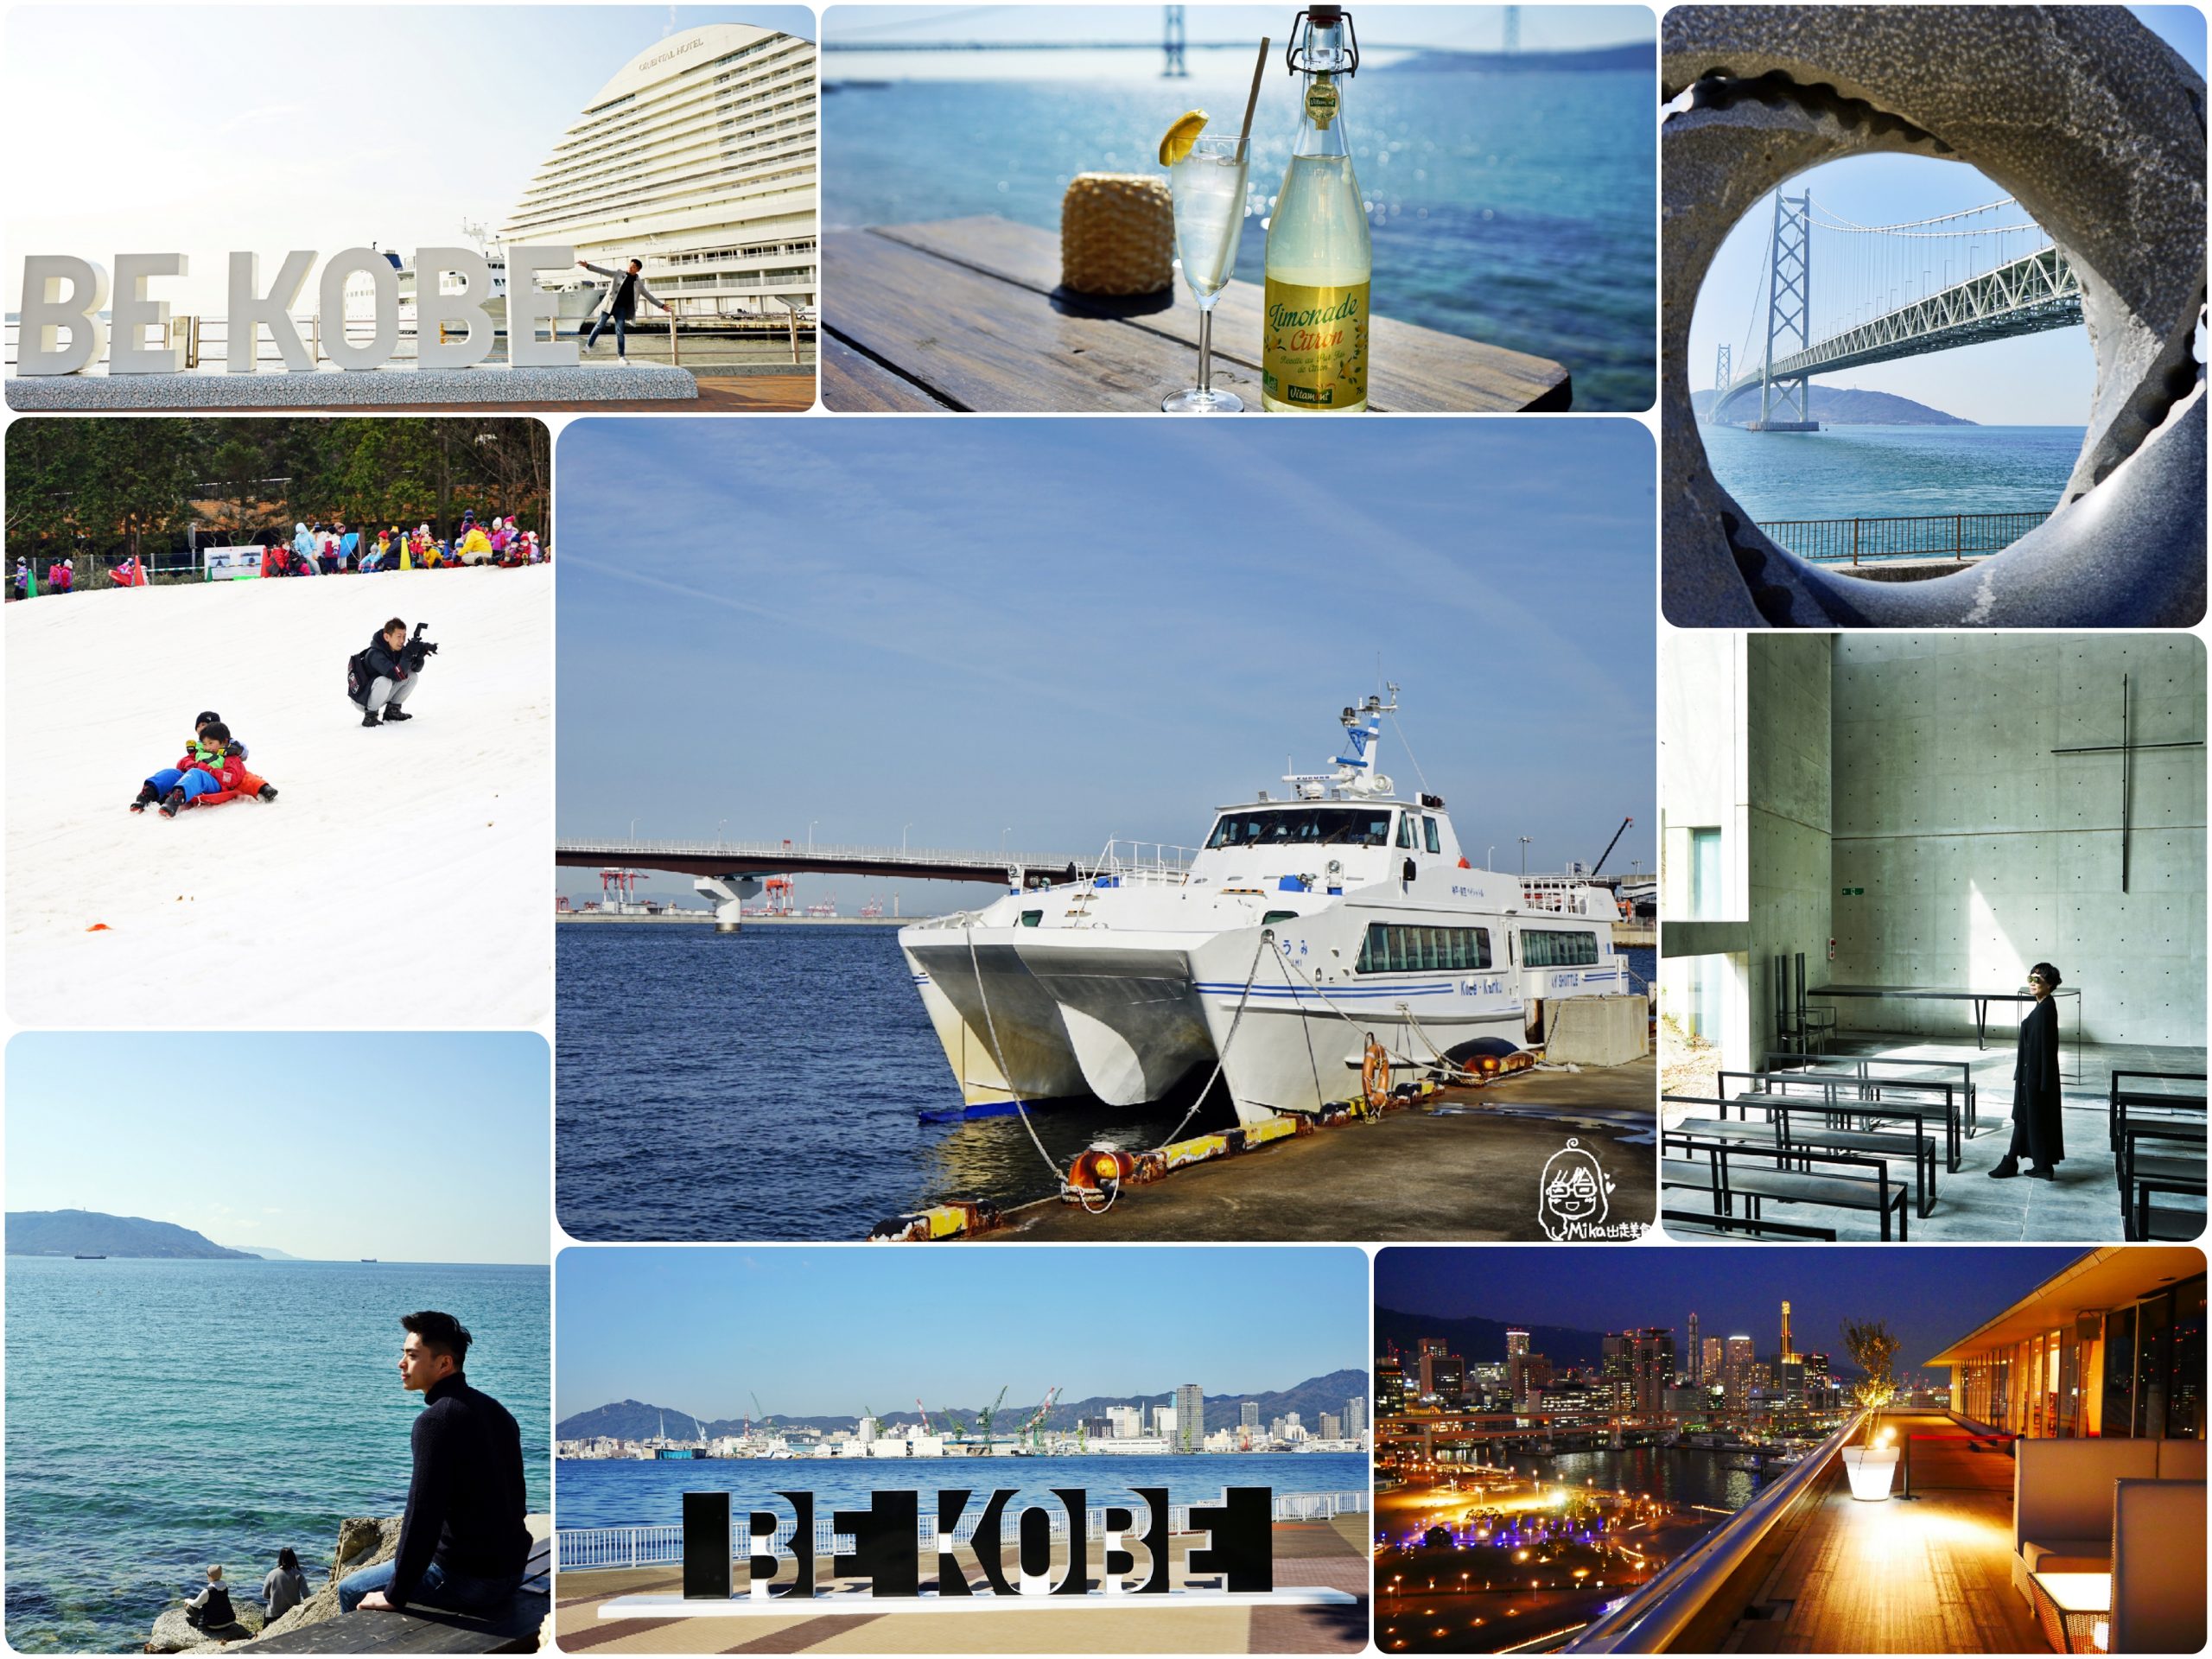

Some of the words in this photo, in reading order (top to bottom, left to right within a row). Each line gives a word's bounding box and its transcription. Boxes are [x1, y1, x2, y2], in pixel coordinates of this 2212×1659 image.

[639, 50, 676, 71] ORIENTAL
[677, 38, 704, 55] HOTEL
[16, 251, 189, 377] BE
[226, 245, 580, 372] KOBE
[1268, 292, 1359, 333] Limonade
[1290, 328, 1344, 352] Citron
[1290, 386, 1331, 401] Vitamont
[704, 1491, 903, 1599] BE
[921, 1486, 1259, 1596] KOBE
